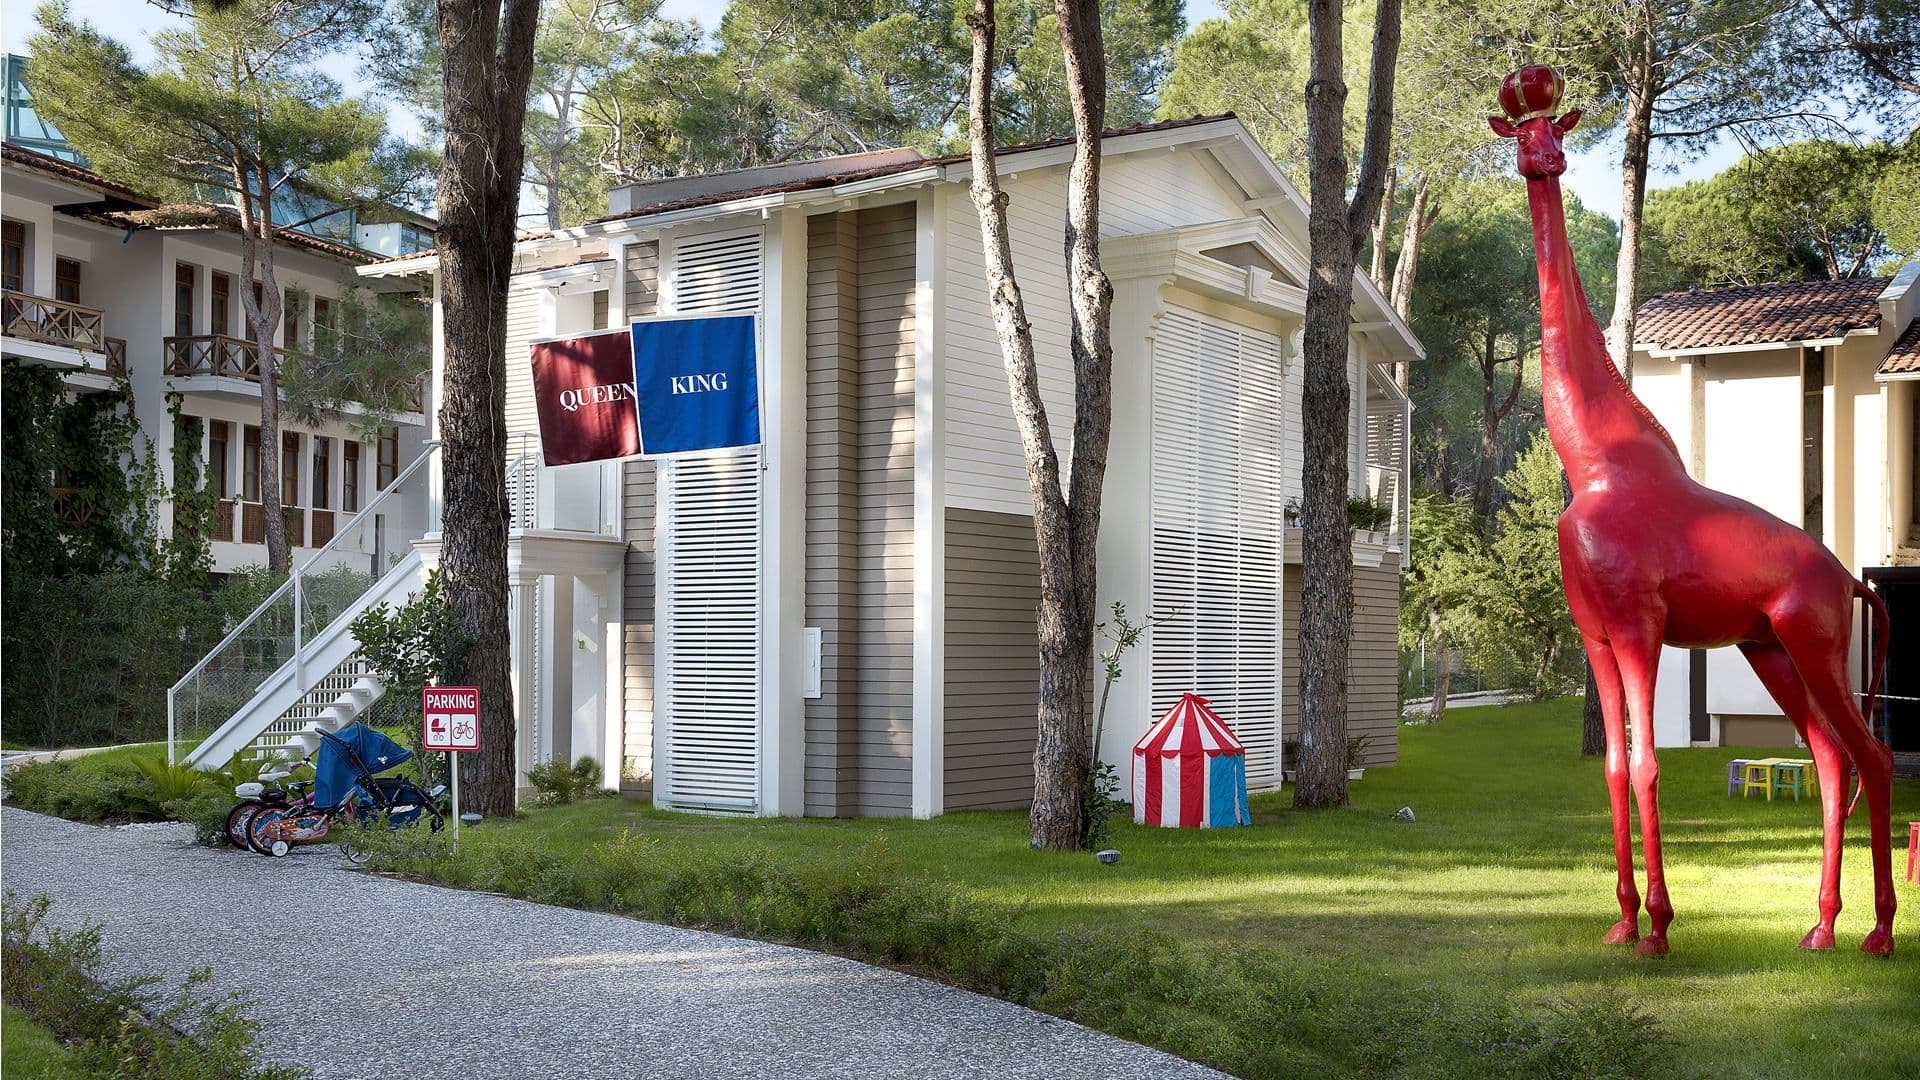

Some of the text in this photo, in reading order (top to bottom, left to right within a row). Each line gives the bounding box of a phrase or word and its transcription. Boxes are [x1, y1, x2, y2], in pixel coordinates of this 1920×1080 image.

[671, 372, 728, 395] KING
[559, 381, 636, 412] QUEEN
[426, 694, 475, 709] PARKING
